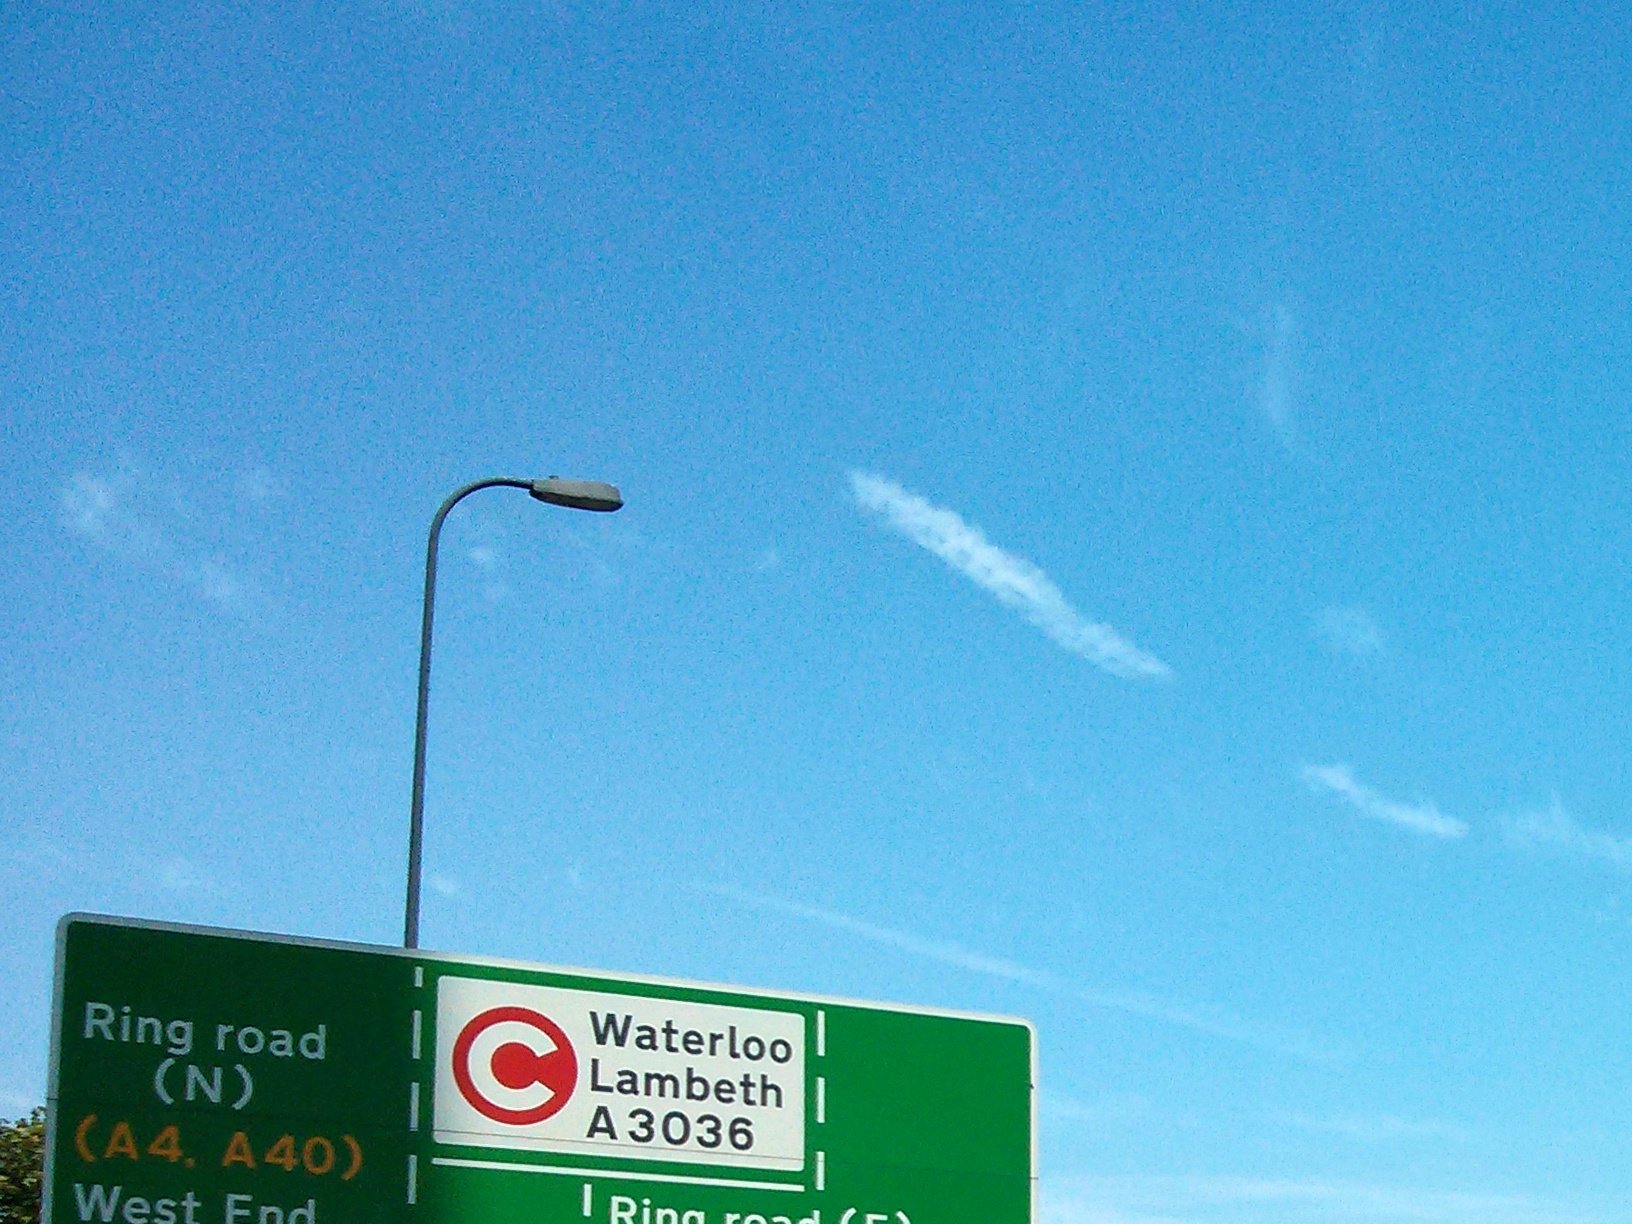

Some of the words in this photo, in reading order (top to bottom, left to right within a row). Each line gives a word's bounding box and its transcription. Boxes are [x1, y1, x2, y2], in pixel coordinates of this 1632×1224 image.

[82, 1001, 194, 1056] Ring
[215, 1023, 327, 1060] road
[588, 1010, 794, 1065] Waterloo
[153, 1057, 254, 1110] (N)
[589, 1057, 784, 1109] Lambeth
[585, 1104, 755, 1151] A3036
[220, 1130, 363, 1180] A40)
